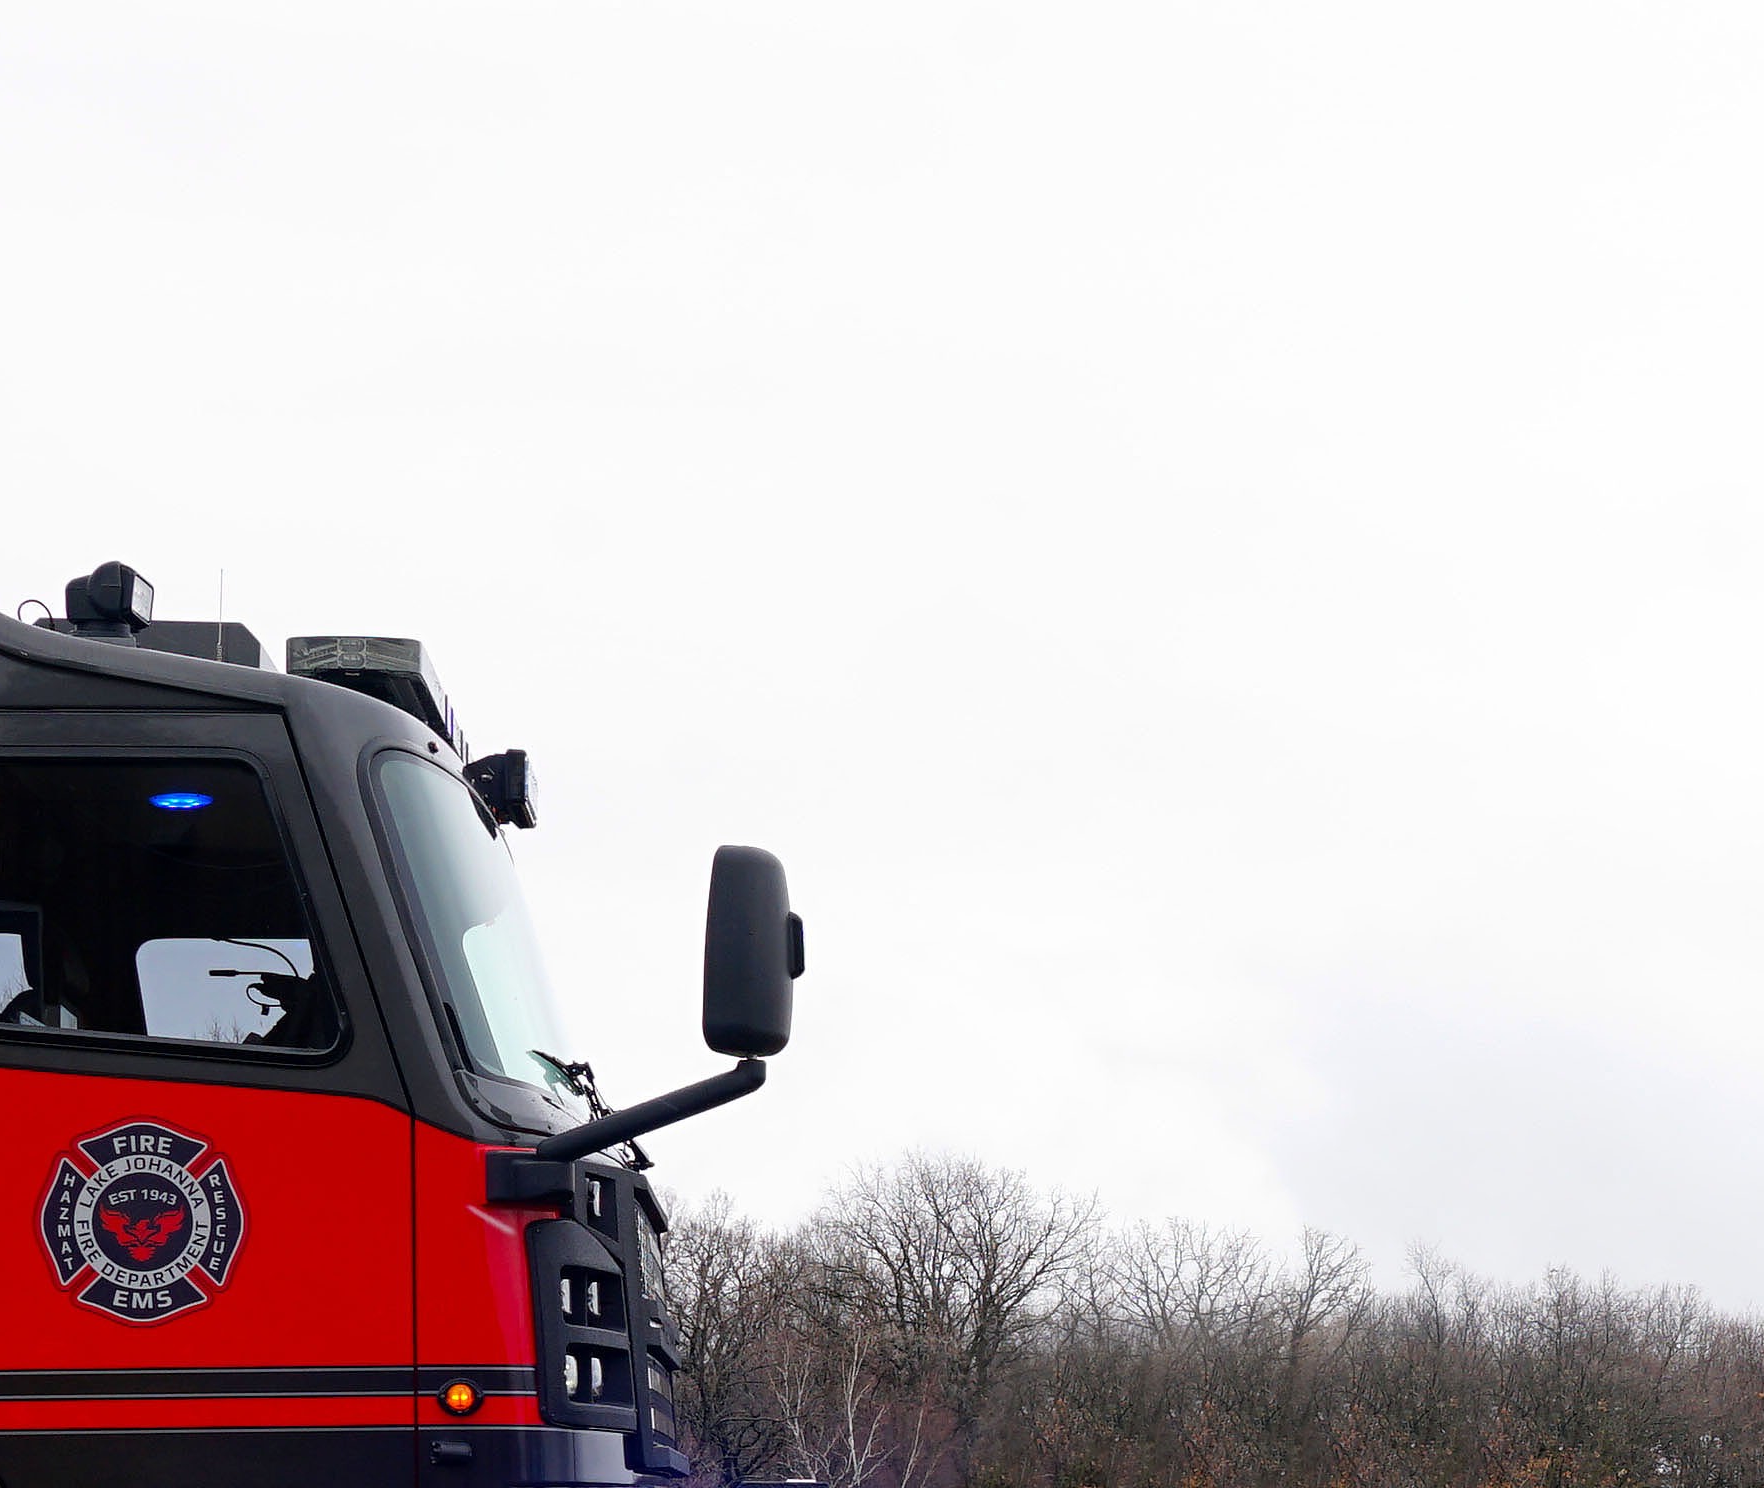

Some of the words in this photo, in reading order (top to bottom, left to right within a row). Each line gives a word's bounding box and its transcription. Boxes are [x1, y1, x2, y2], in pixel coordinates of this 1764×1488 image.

[112, 1134, 173, 1155] FIRE
[79, 1164, 120, 1209] LAKE
[123, 1157, 205, 1209] JOHANNA
[108, 1189, 137, 1206] EST
[141, 1189, 178, 1206] 1943
[57, 1173, 76, 1271] HAZMAT
[208, 1173, 227, 1271] RESCUE
[77, 1219, 102, 1264] FIRE
[101, 1222, 209, 1287] DEPARTMENT
[113, 1290, 173, 1310] EMS
